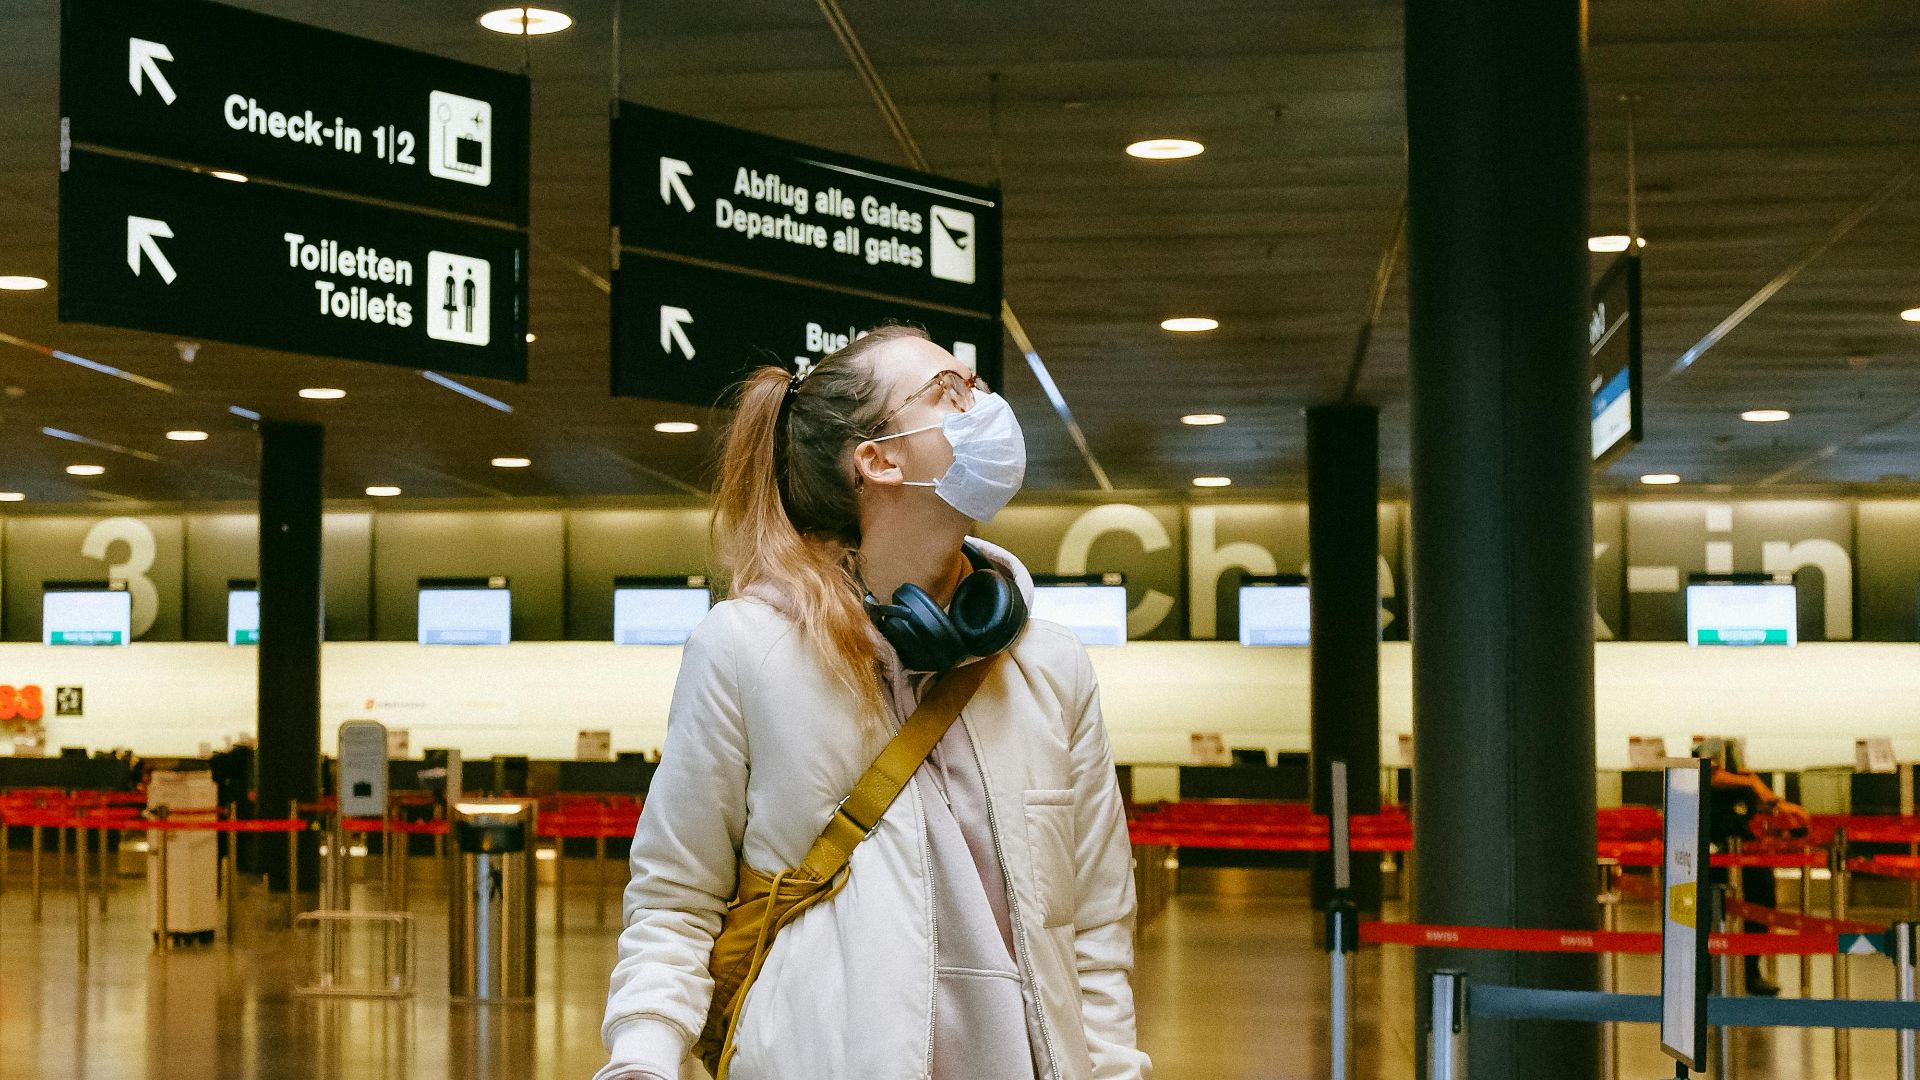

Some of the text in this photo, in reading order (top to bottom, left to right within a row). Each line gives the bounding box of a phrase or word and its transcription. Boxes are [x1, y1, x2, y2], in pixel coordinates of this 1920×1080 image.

[224, 93, 362, 154] Check-in
[733, 166, 923, 235] Abflug alle Gates
[283, 232, 413, 287] Toiletten
[715, 198, 923, 269] Departure all gates
[314, 279, 413, 328] Toilets
[81, 515, 159, 640] 3
[1425, 930, 1459, 943] SWISS
[1559, 935, 1594, 948] SWISS
